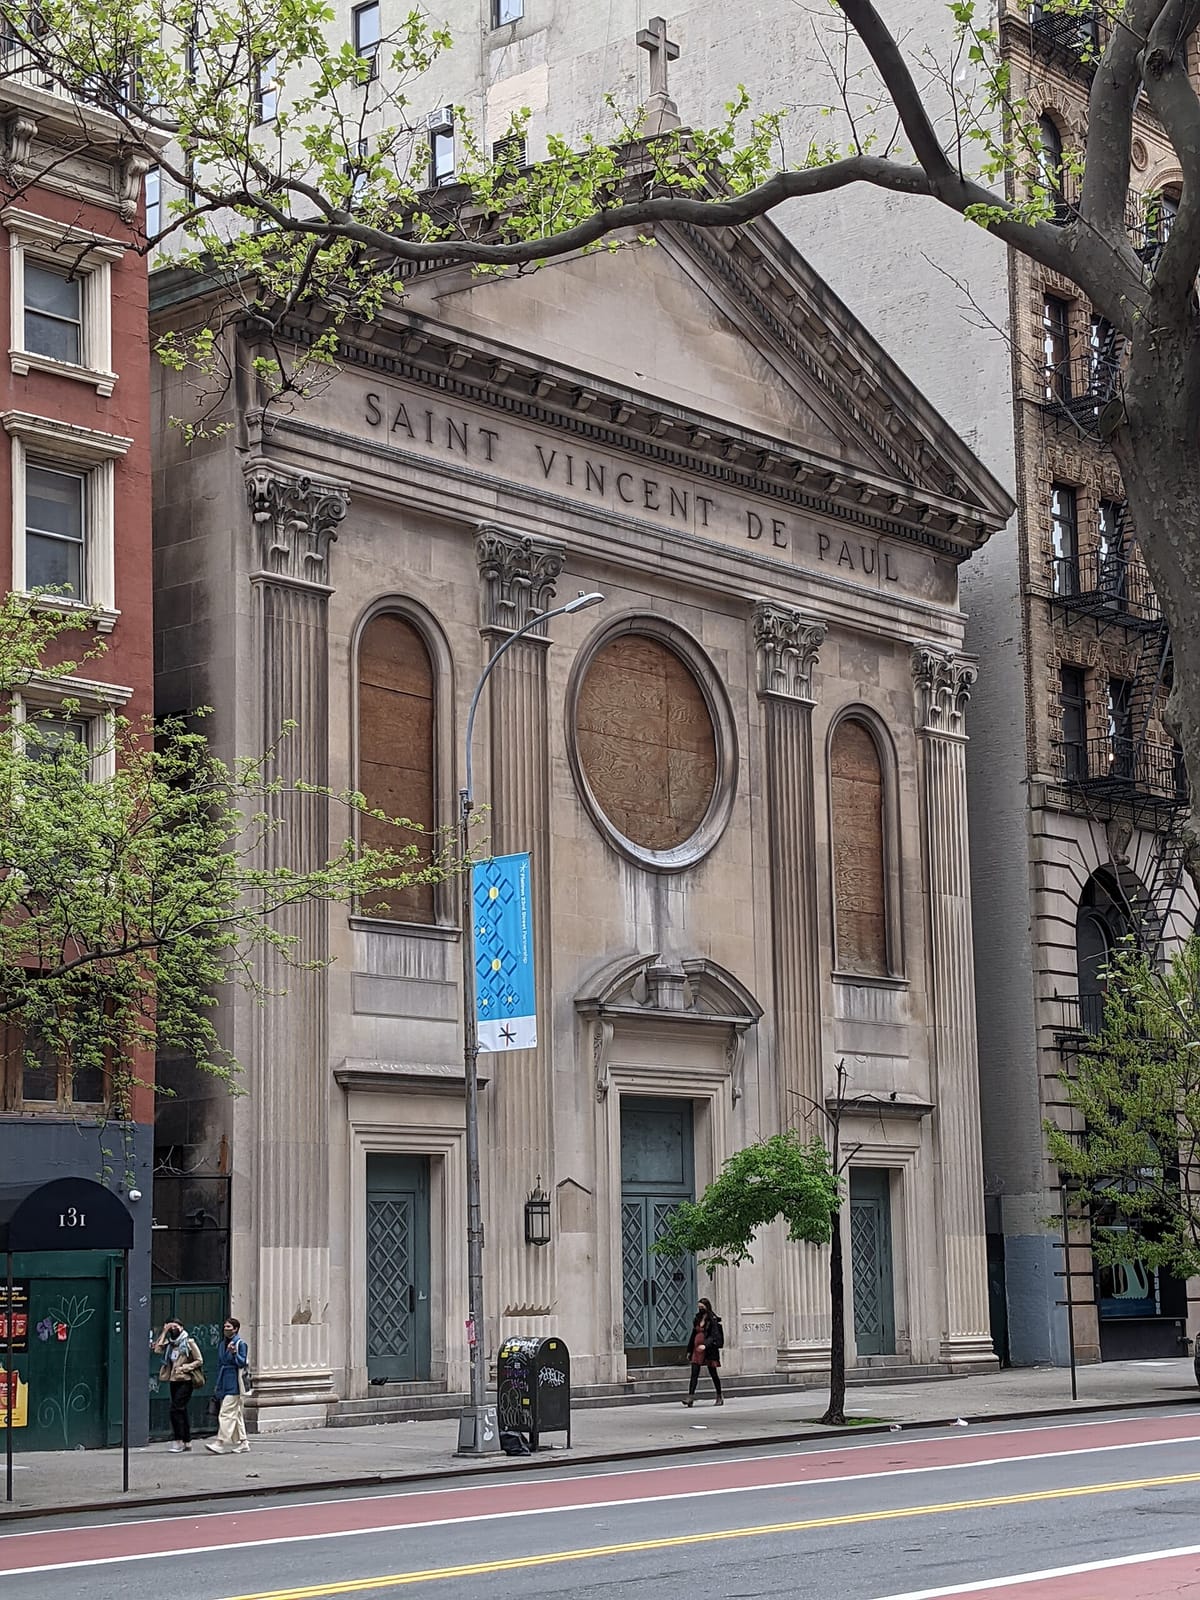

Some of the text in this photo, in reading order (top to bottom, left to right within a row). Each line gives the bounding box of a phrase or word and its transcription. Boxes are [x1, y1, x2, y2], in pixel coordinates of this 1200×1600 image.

[364, 393, 900, 583] SAINT VINCENT DE PAUL
[59, 1207, 86, 1227] 131
